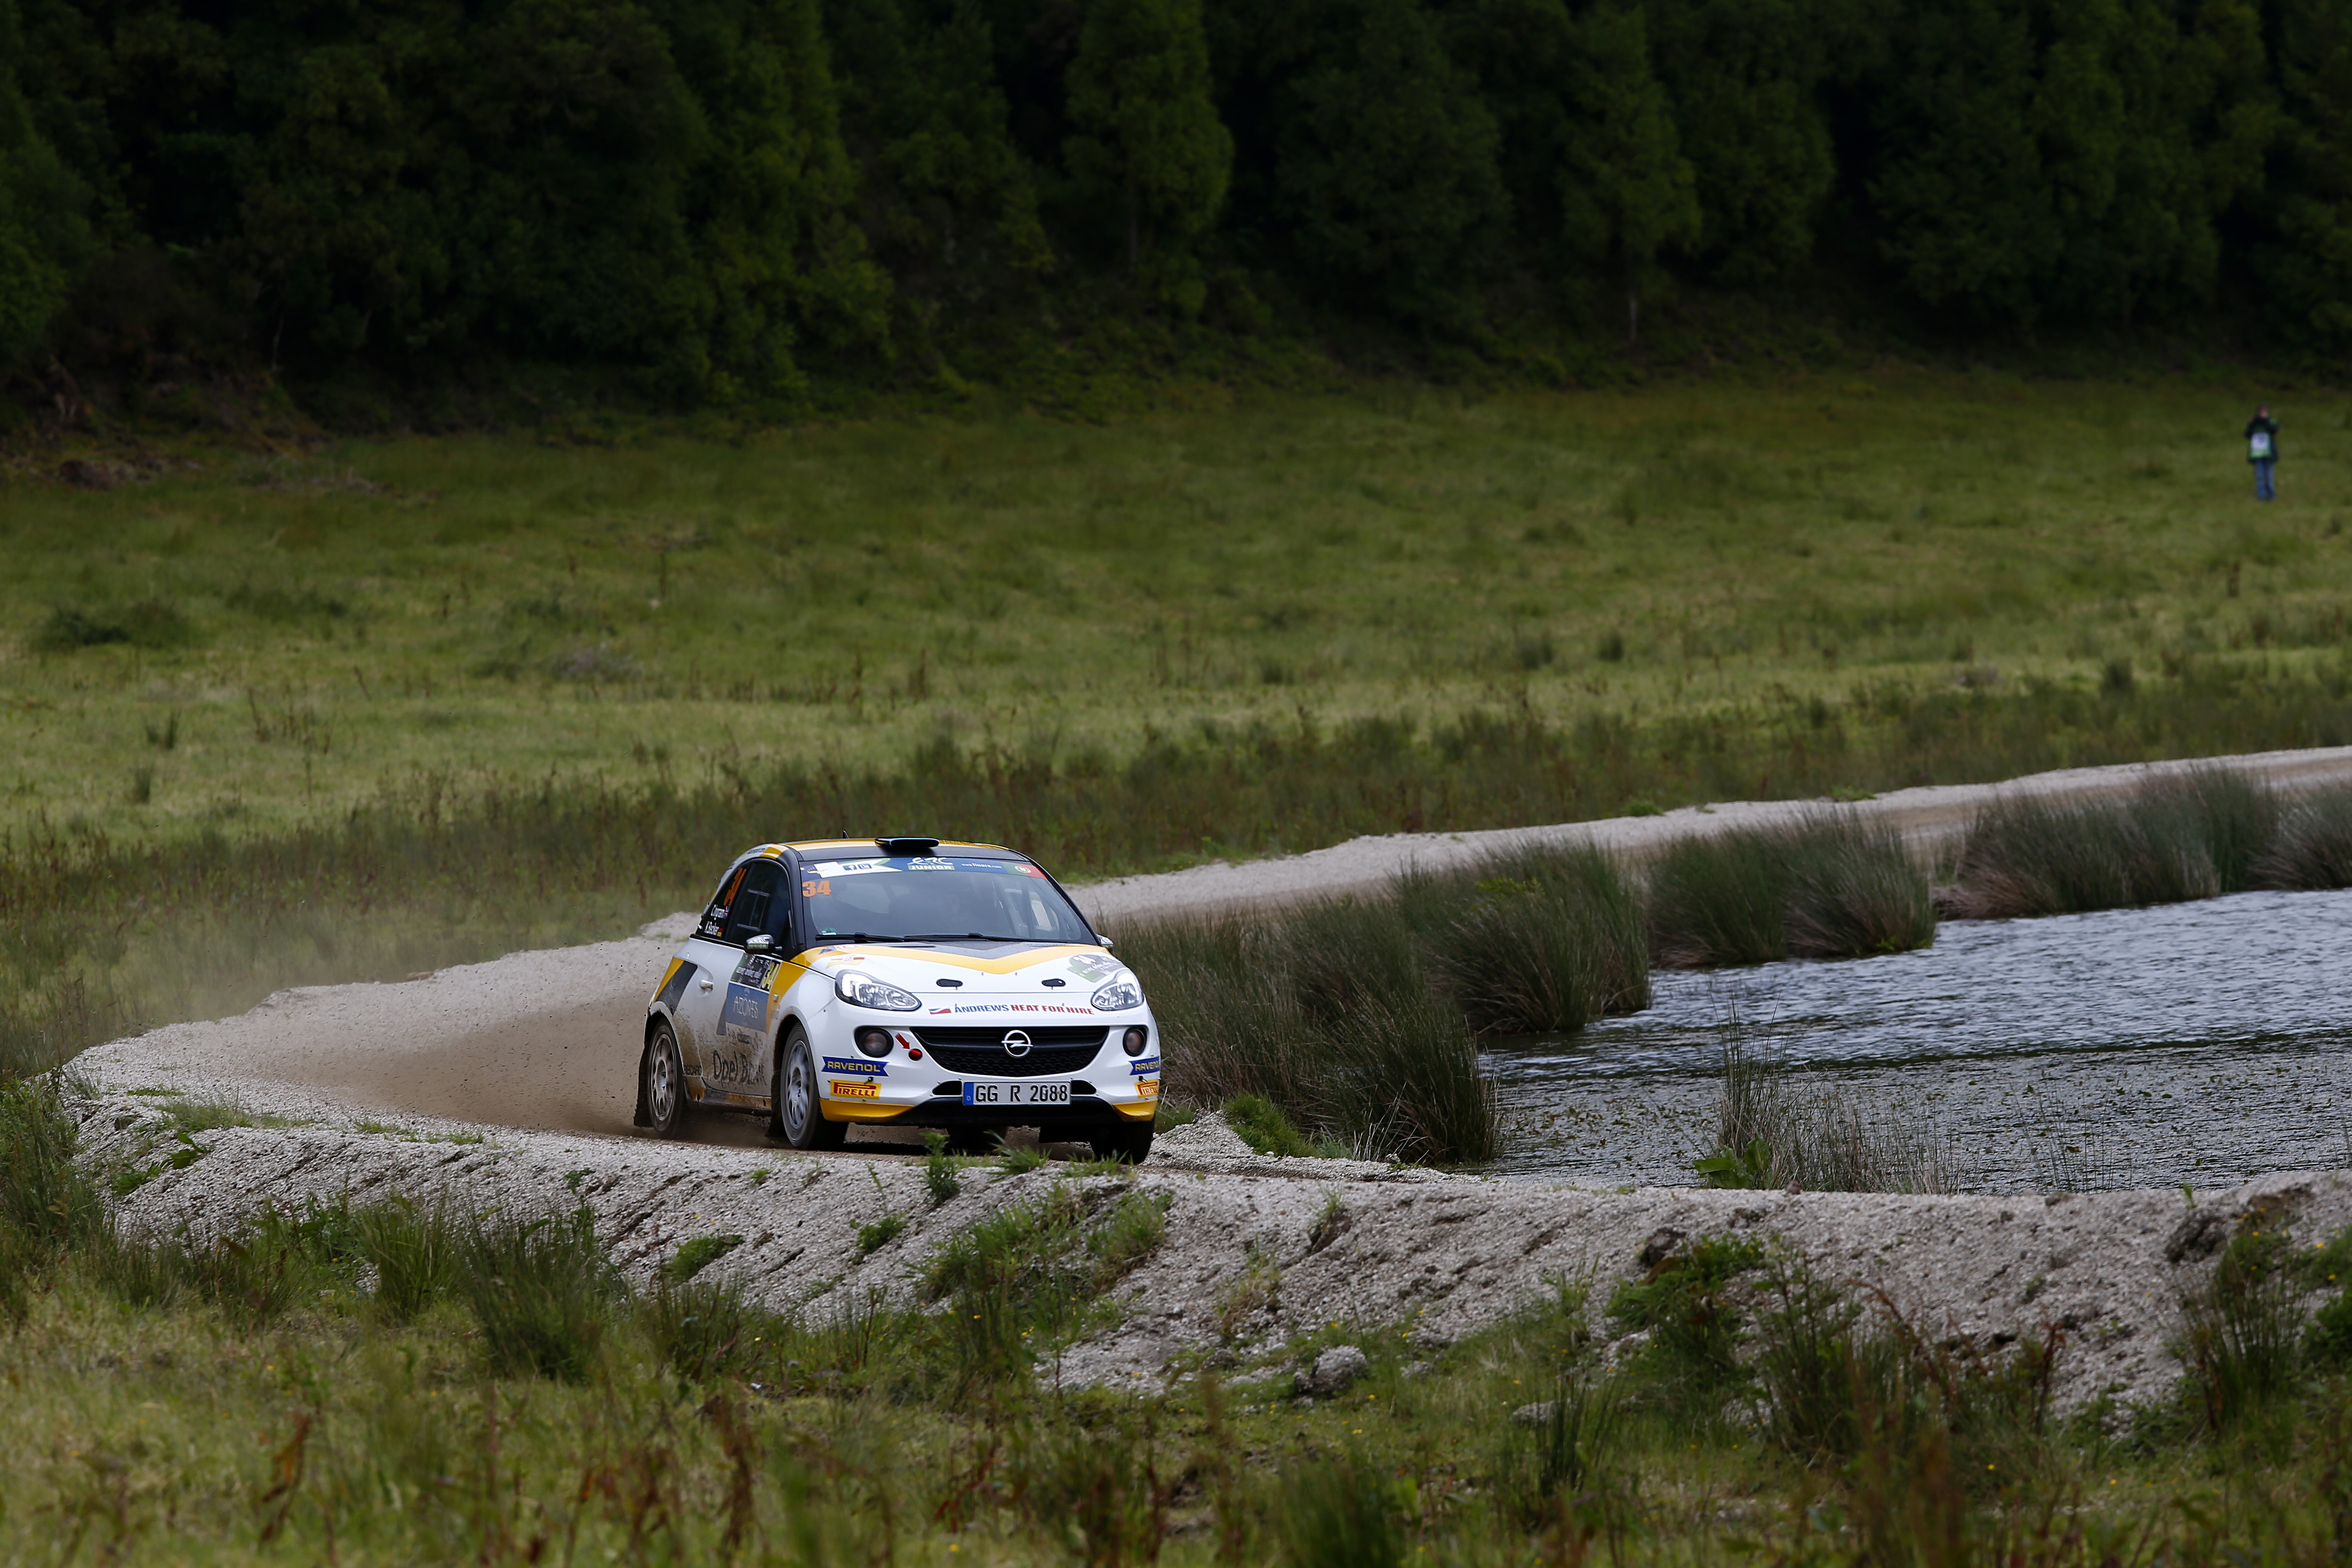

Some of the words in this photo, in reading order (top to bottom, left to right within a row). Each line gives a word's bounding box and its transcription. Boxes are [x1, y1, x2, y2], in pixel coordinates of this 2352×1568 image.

[802, 880, 832, 897] 34
[762, 962, 779, 990] 34
[733, 996, 758, 1019] AZORES
[955, 1005, 1010, 1013] ANDREWS
[1011, 1004, 1040, 1012] HEAT
[1066, 1007, 1095, 1015] HIRE
[827, 1061, 881, 1072] RAVENOL
[834, 1082, 877, 1097] PIRELLI
[976, 1085, 998, 1102] GG
[1010, 1085, 1021, 1102] R
[1030, 1085, 1068, 1102] 2088
